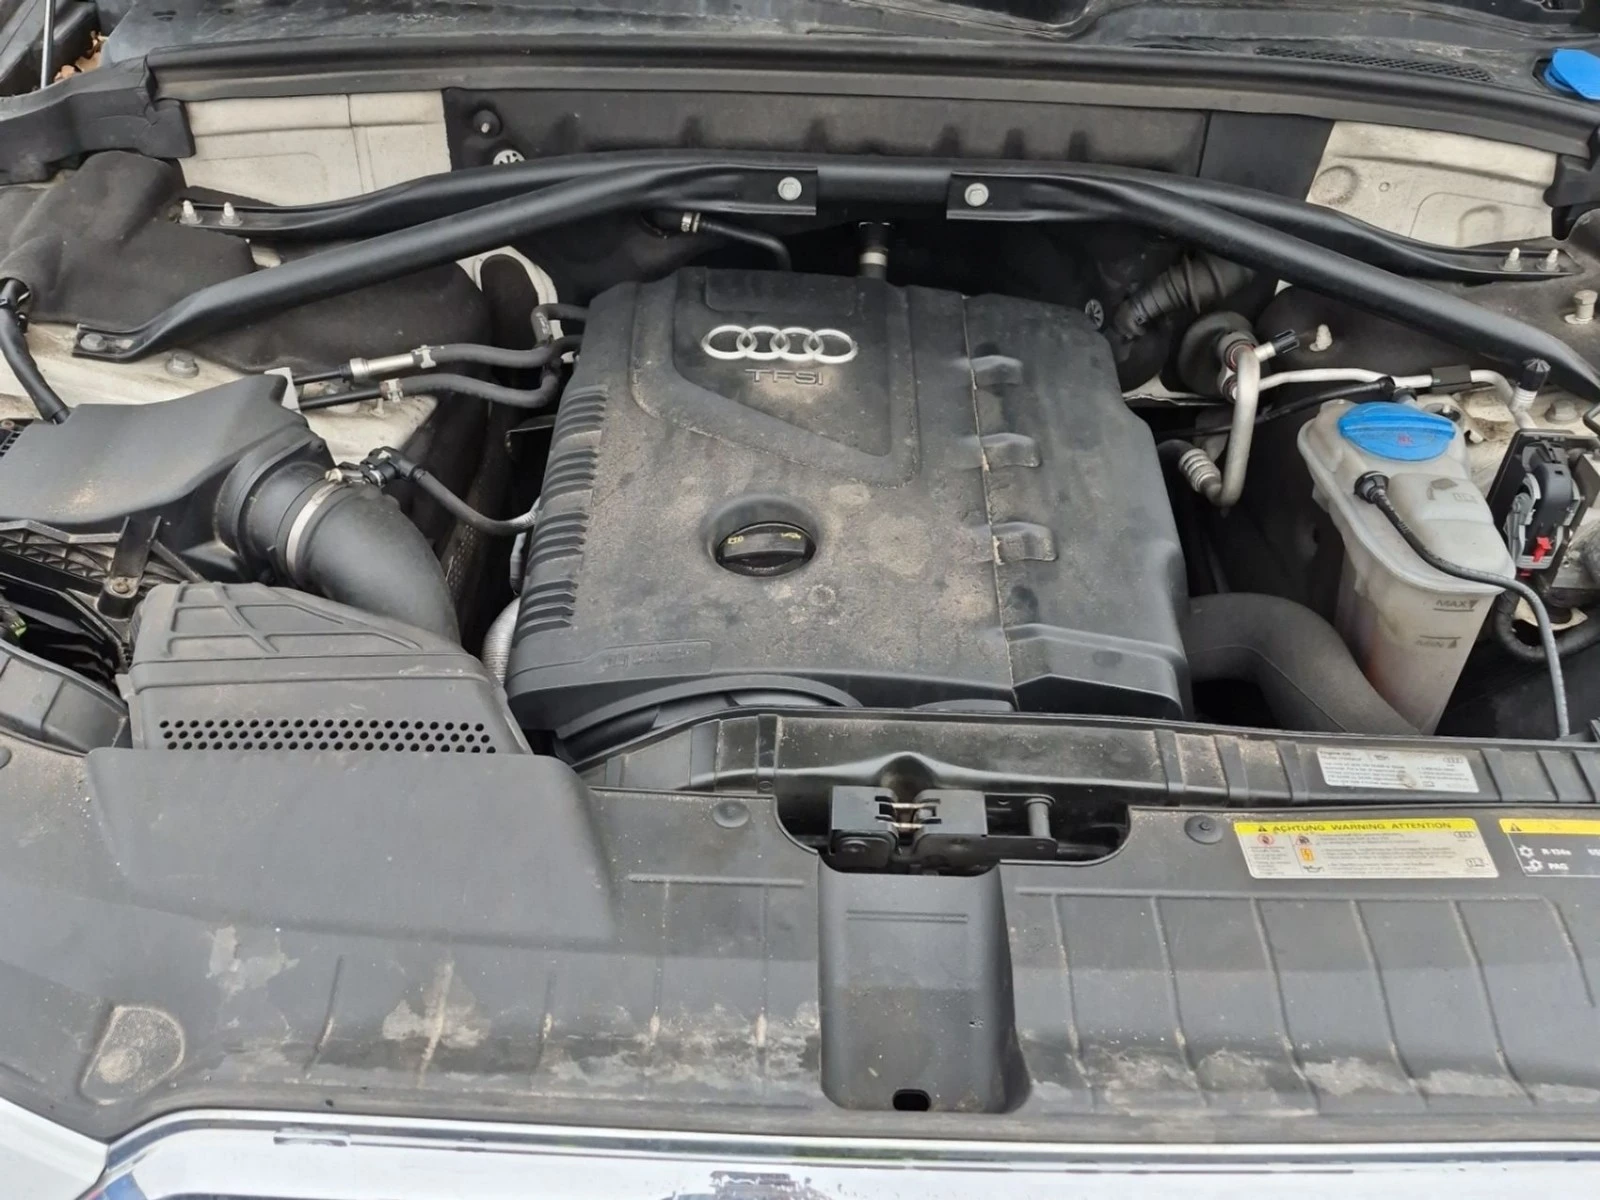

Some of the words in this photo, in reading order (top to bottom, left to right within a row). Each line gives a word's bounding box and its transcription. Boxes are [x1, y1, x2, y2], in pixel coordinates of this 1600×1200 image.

[745, 368, 824, 386] TFSI
[1435, 599, 1466, 608] MAX
[1414, 639, 1444, 649] MIN
[1272, 824, 1326, 833] ACHTUNG
[1331, 823, 1387, 831] WARNING
[1391, 822, 1452, 830] ATTENTION
